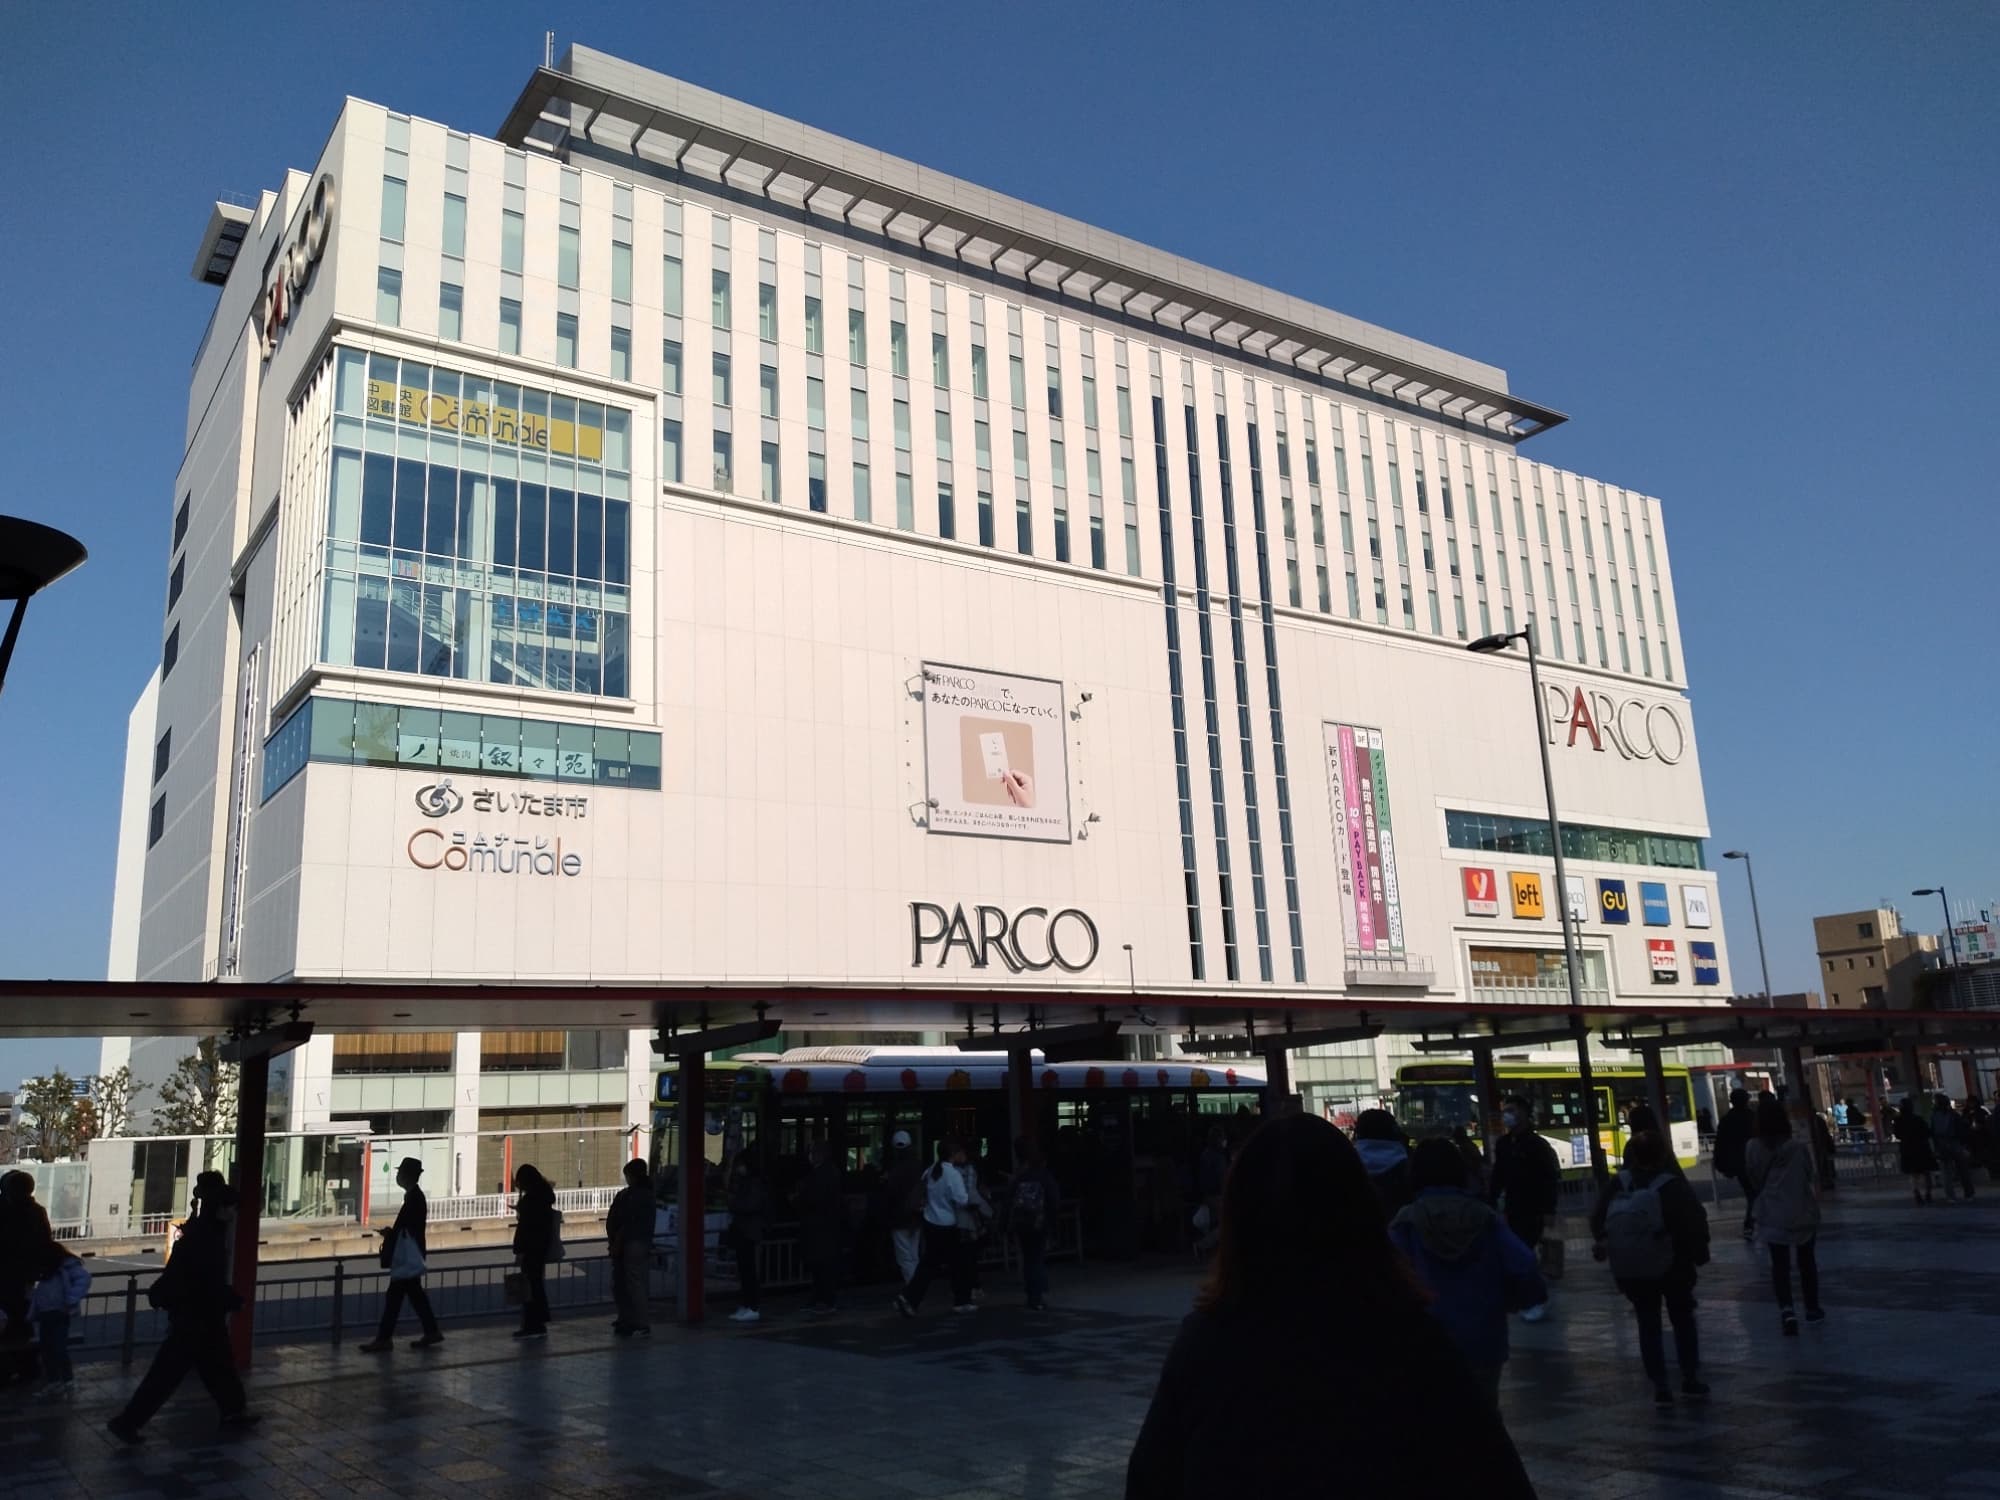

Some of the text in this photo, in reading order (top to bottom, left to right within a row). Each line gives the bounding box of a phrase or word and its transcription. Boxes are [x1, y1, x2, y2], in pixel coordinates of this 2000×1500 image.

[366, 396, 413, 418] 図書館
[420, 393, 549, 447] Comunale
[931, 692, 1058, 720] あなたのPARCOになっていく。
[1540, 681, 1687, 765] PARCO
[472, 787, 588, 819] さいたま市
[407, 827, 583, 877] Comunale
[452, 831, 549, 851] コムナーレ
[1353, 831, 1366, 898] PAYBACK
[1602, 889, 1627, 911] GU
[908, 901, 1099, 975] PARCO
